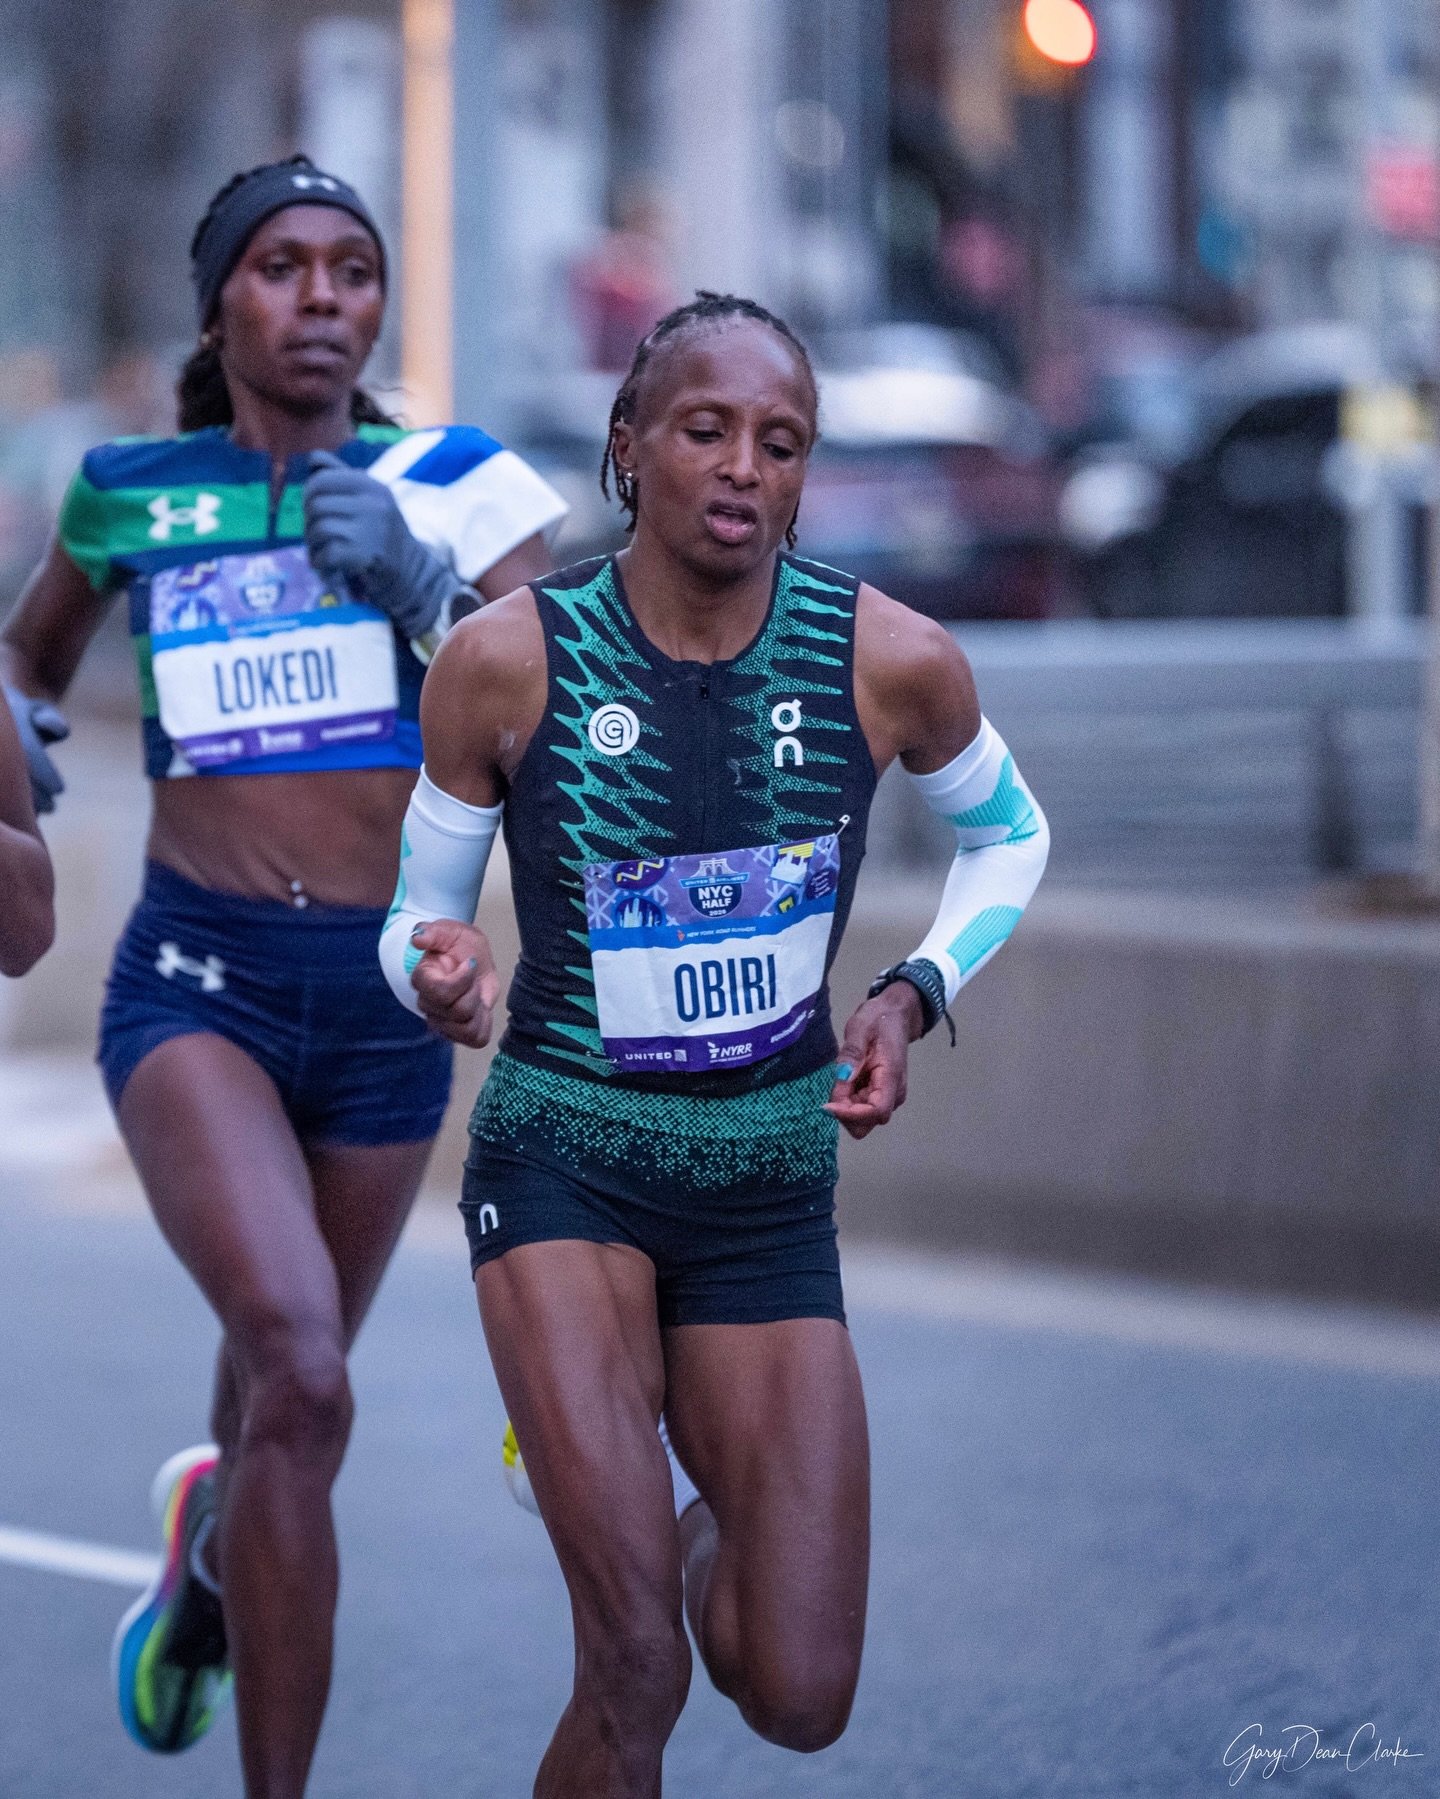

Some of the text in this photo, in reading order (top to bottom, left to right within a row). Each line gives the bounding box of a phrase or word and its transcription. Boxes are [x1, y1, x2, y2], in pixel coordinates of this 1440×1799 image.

[214, 647, 338, 715] LOKEDI
[698, 885, 733, 900] NYC
[702, 898, 732, 909] HALF
[674, 953, 776, 1023] OBIRI
[625, 1052, 673, 1061] UNITED
[720, 1042, 753, 1058] NYRR
